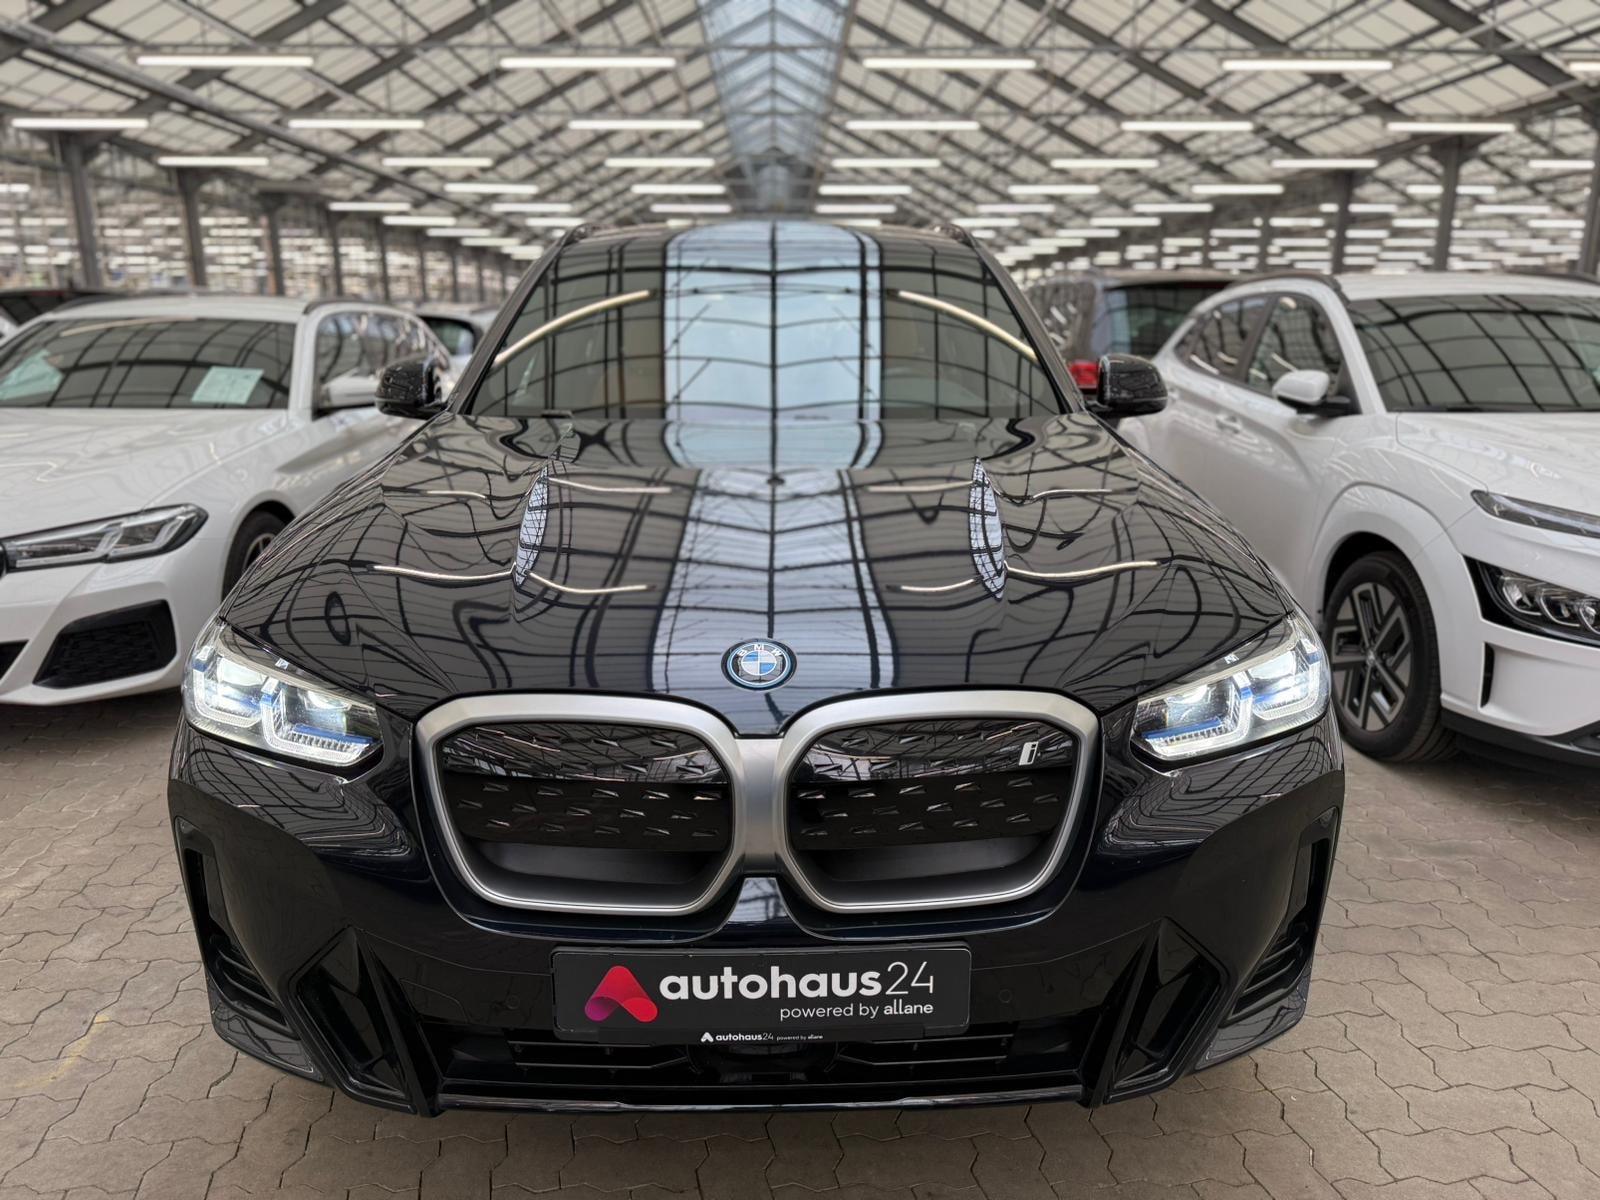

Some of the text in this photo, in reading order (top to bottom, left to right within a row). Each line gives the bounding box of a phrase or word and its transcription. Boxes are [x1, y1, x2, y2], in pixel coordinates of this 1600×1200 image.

[737, 644, 782, 656] BMW
[659, 961, 934, 1000] autohaus24
[780, 999, 934, 1021] powered by allane
[716, 1032, 774, 1041] autohaus24
[776, 1034, 799, 1042] powered
